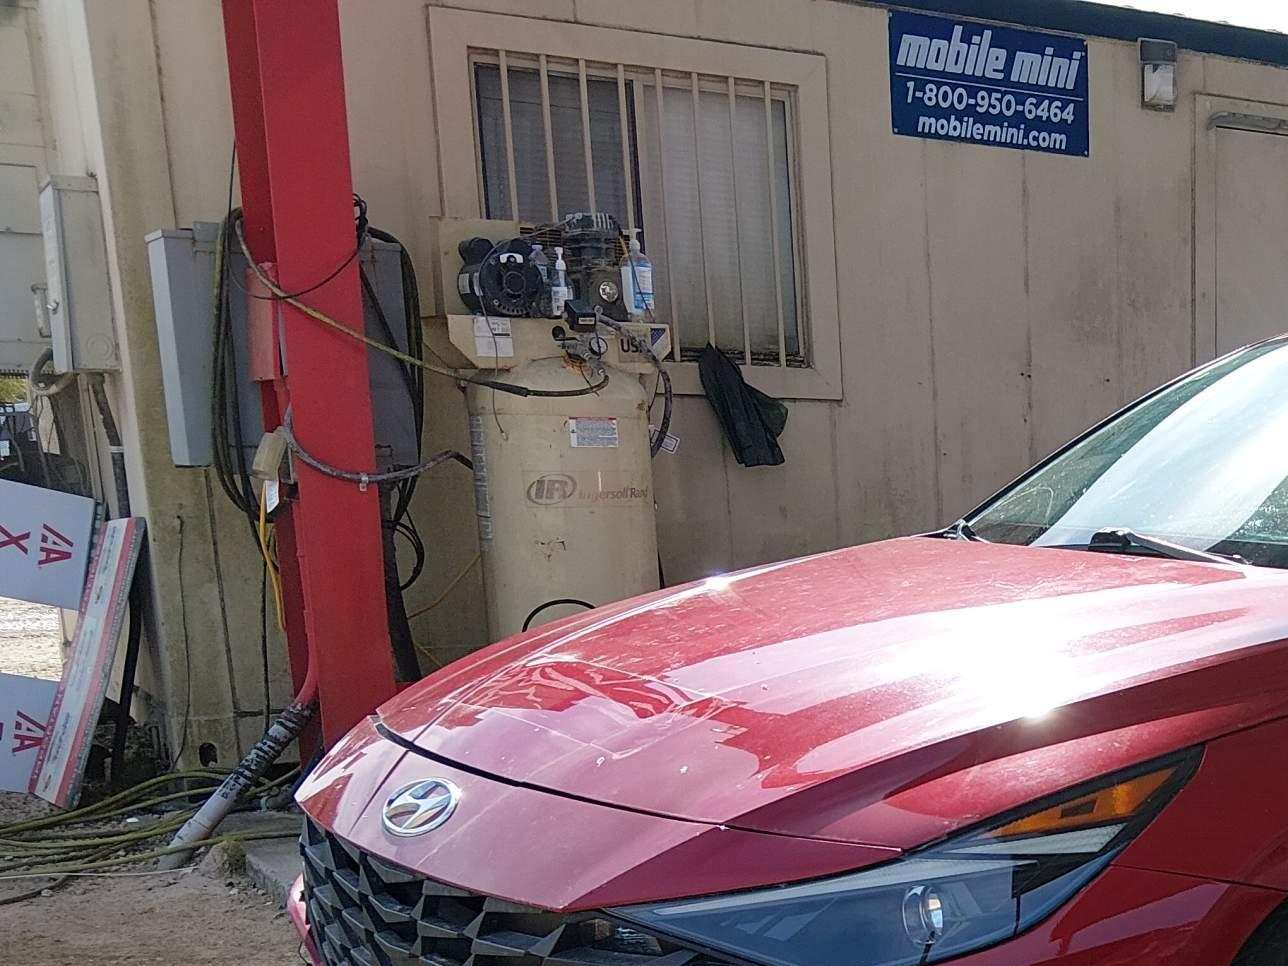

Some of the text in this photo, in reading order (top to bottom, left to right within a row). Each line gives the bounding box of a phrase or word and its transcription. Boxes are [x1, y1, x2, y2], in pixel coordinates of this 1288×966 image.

[896, 25, 1082, 90] mobile mini
[906, 81, 1075, 124] 1-800-950-6464
[917, 115, 1067, 150] mobilemini.com
